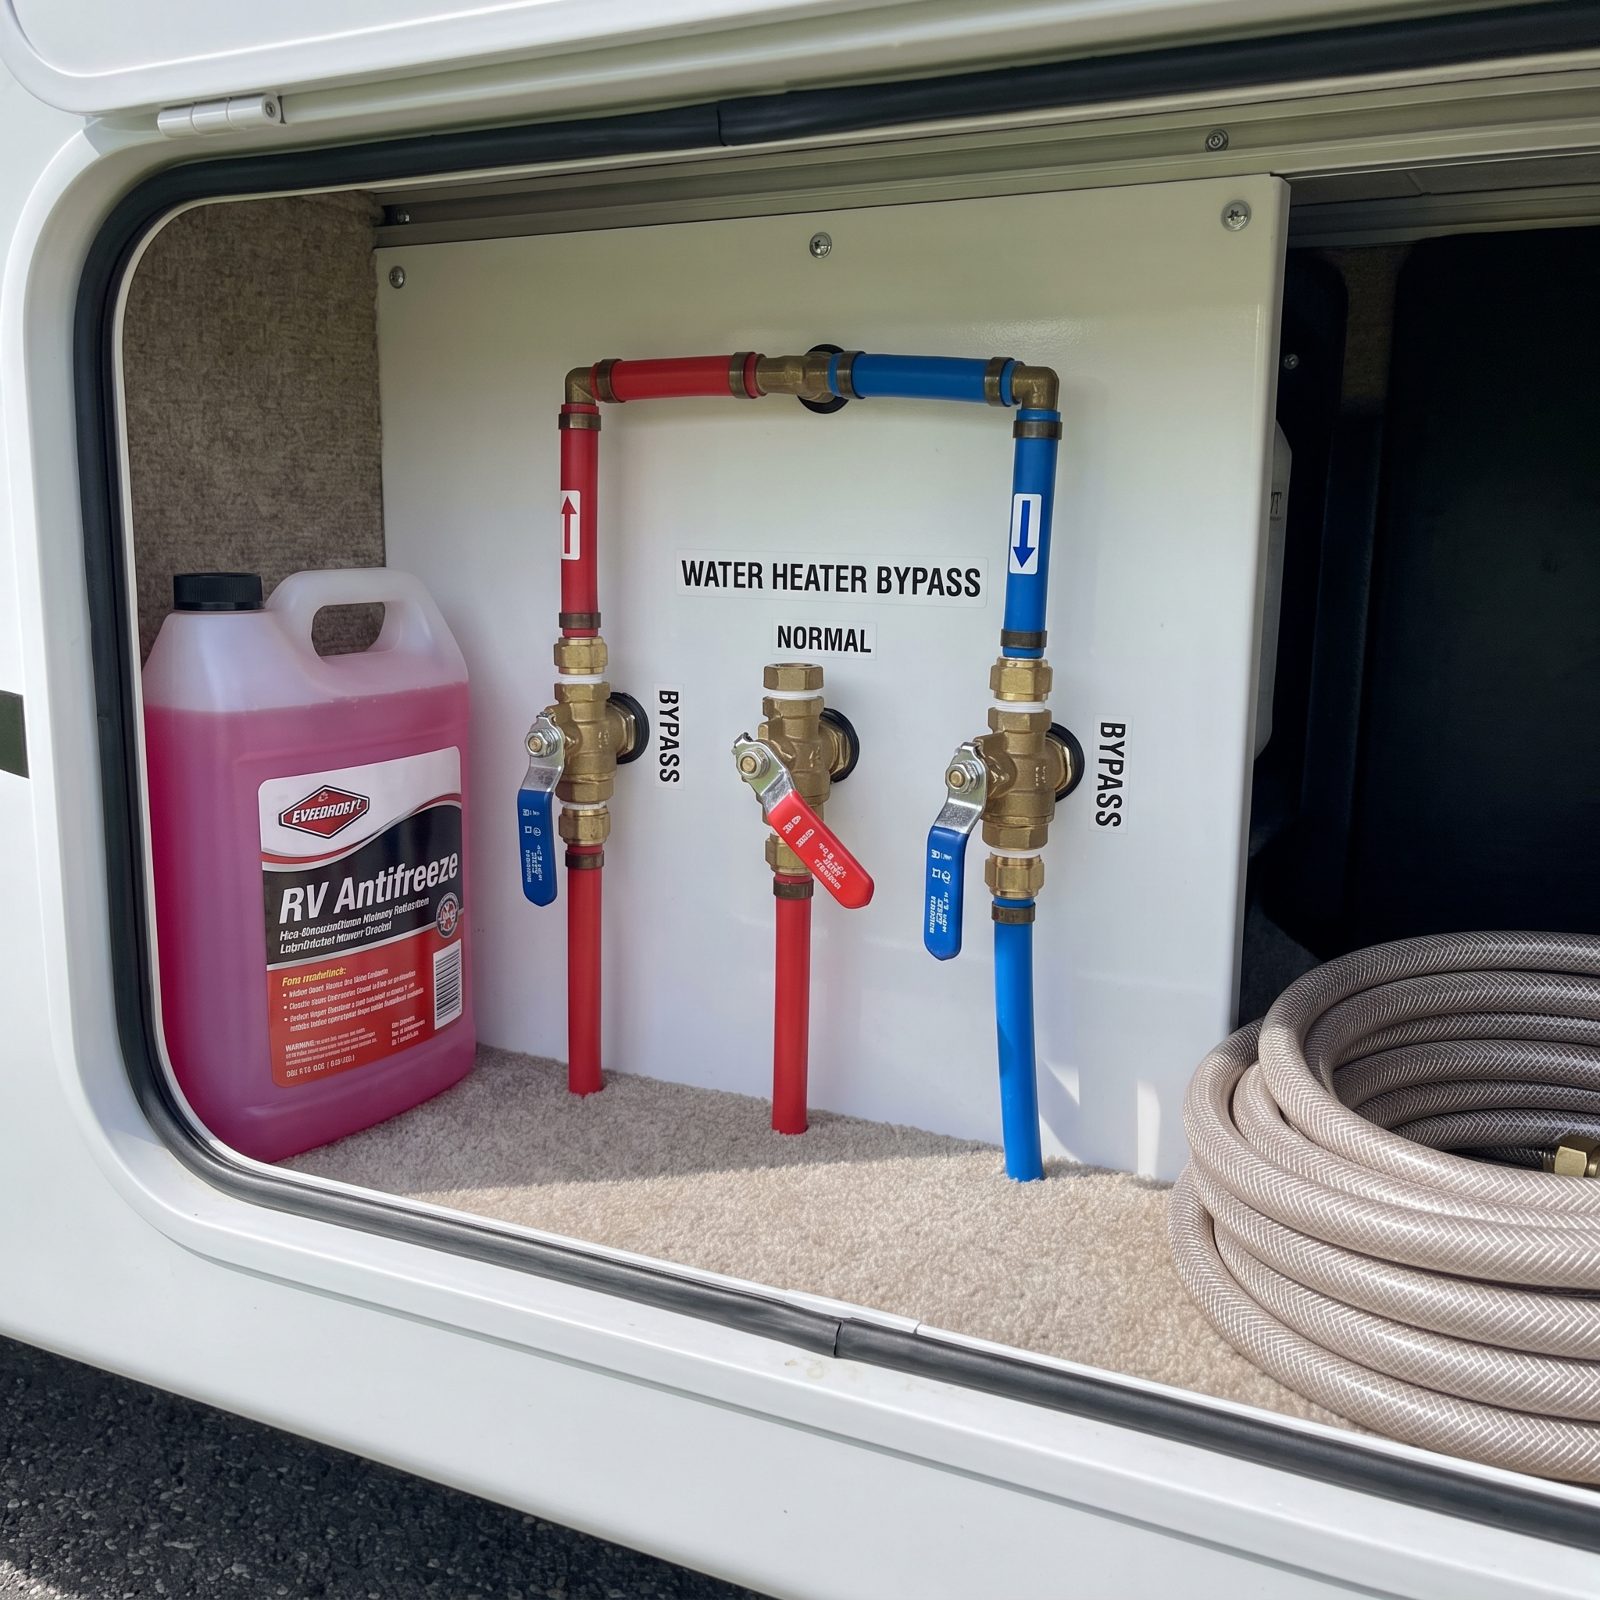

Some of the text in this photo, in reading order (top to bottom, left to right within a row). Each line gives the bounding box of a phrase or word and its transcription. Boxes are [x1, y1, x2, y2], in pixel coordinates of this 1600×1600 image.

[681, 559, 981, 597] WATER HEATER BYPASS
[777, 625, 872, 653] NORMAL
[659, 690, 680, 783] BYPASS
[1095, 722, 1126, 827] BYPASS
[279, 881, 329, 924] RV
[333, 852, 458, 914] Antifreeze
